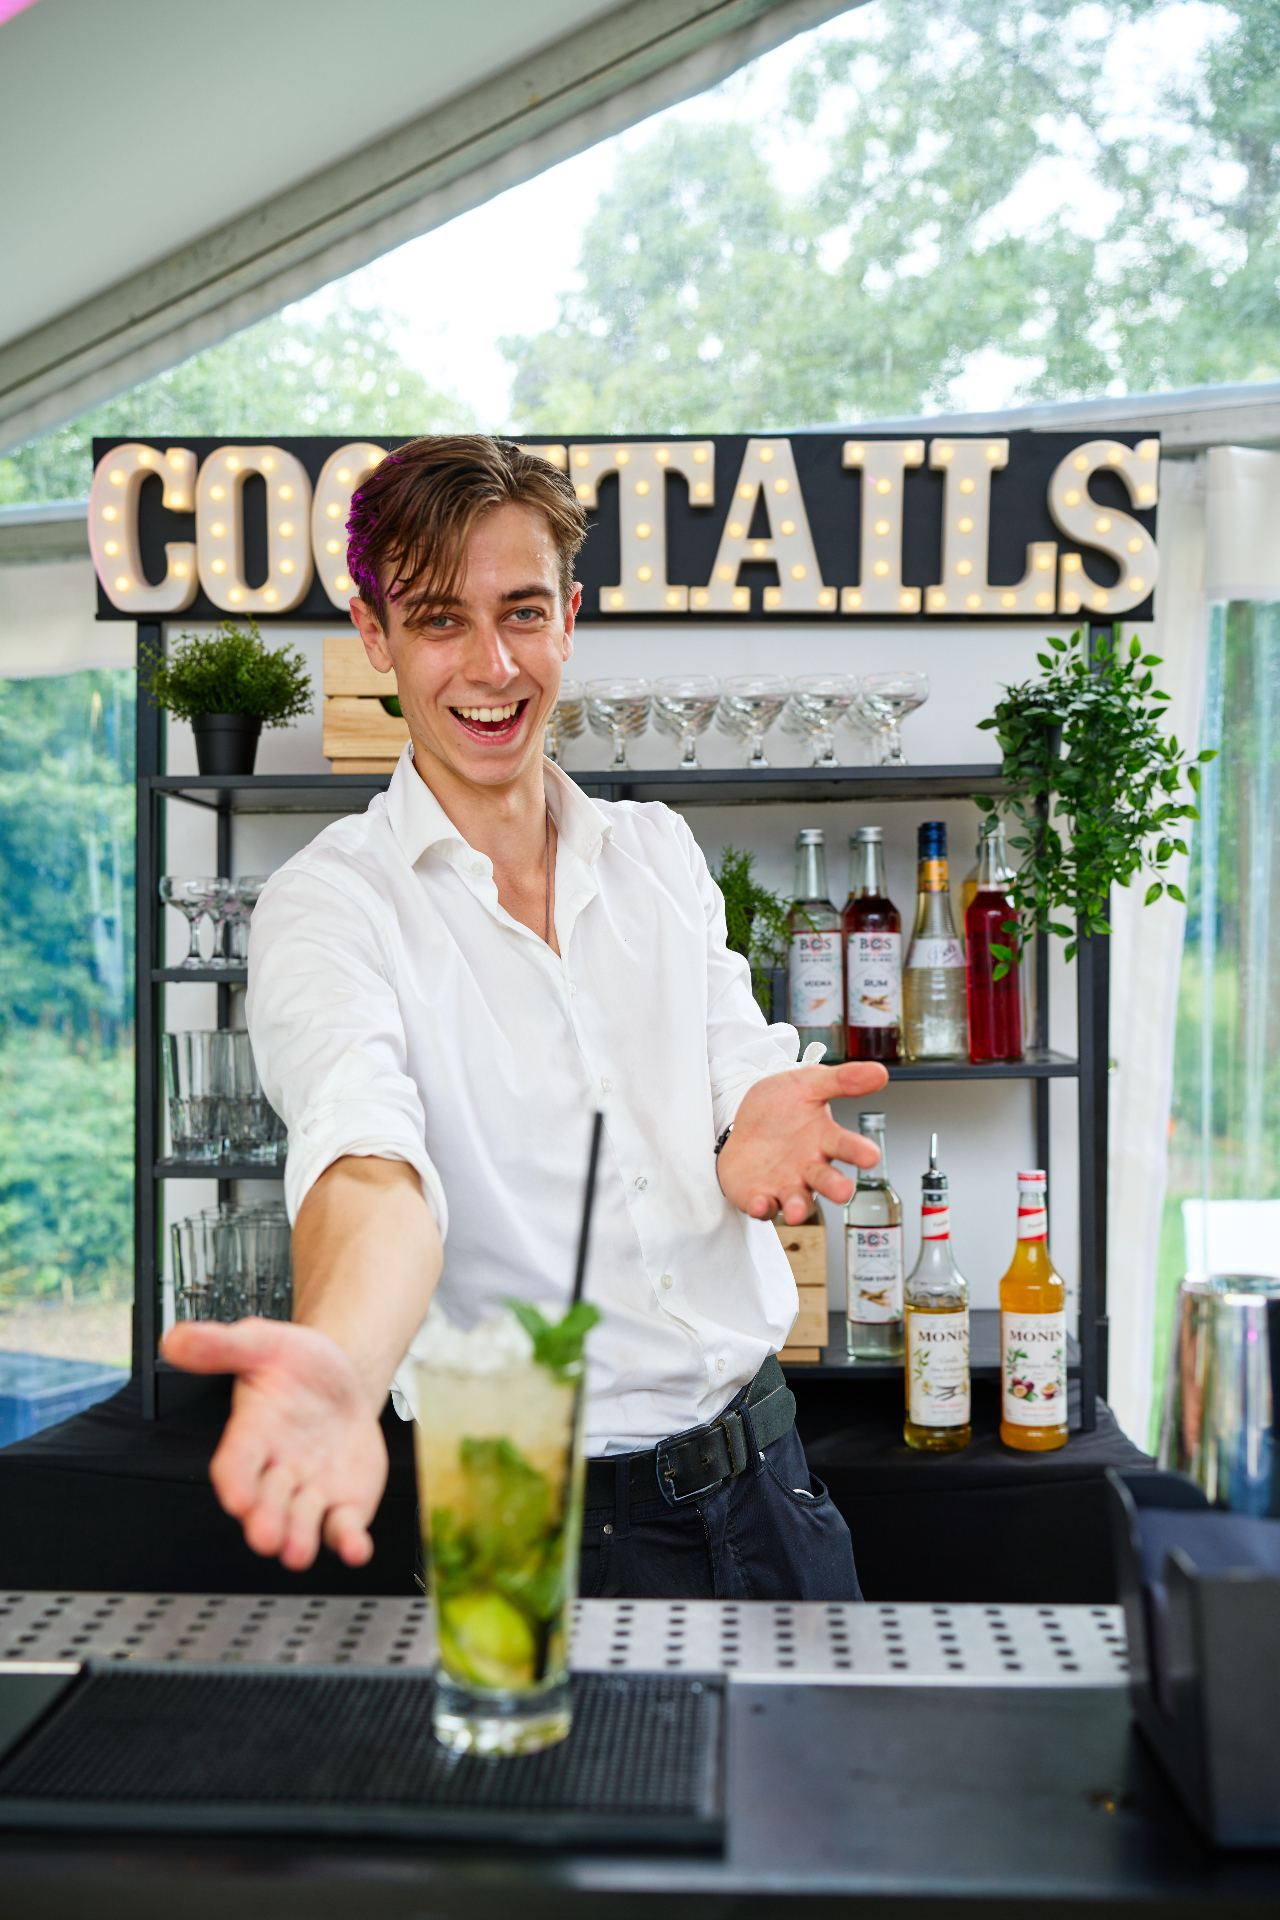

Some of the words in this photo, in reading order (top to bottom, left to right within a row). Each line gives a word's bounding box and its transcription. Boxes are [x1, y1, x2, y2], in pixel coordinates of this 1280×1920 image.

[87, 438, 1160, 614] COTAILS
[863, 979, 888, 988] RUM
[918, 1329, 970, 1343] MONIN
[1010, 1329, 1063, 1343] MONIN
